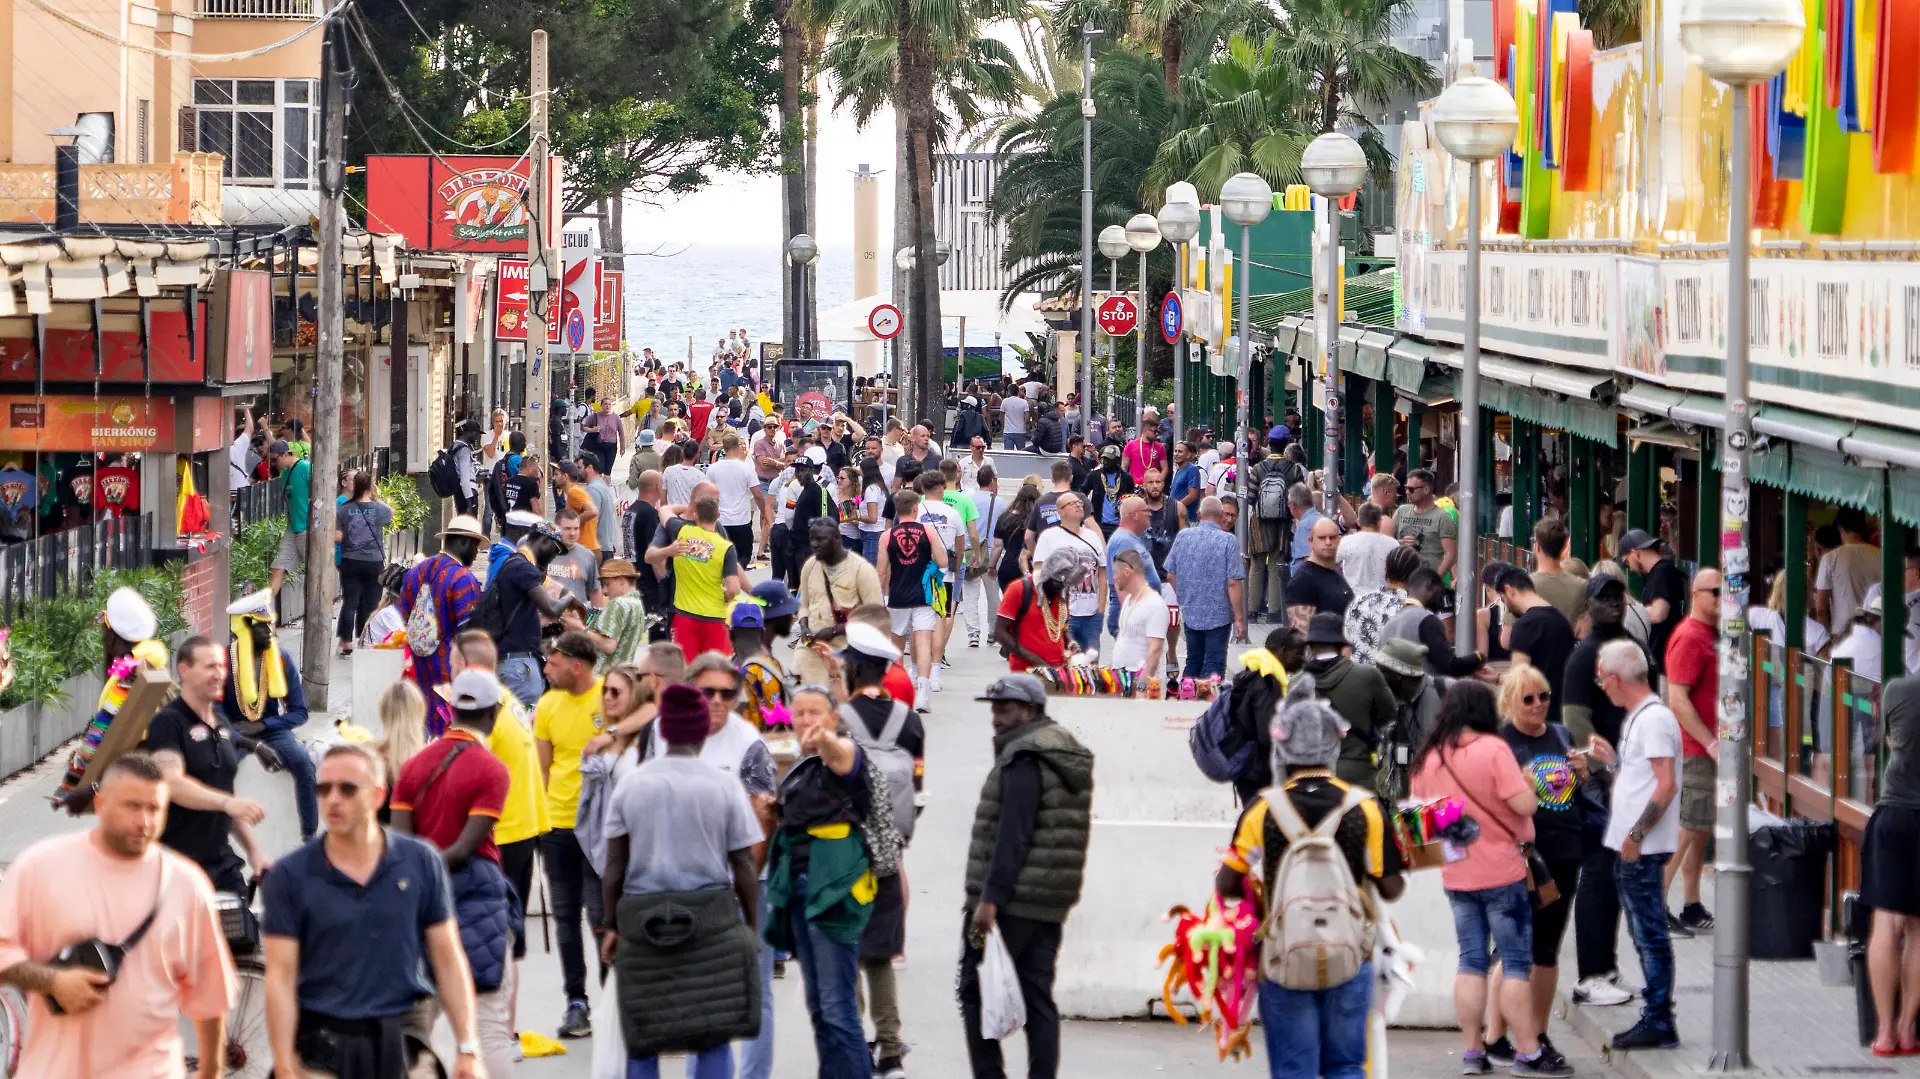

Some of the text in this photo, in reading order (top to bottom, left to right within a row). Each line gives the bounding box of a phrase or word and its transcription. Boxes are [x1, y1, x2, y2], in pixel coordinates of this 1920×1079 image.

[1102, 311, 1134, 321] STOP
[91, 427, 156, 437] BIERKÖNIG
[91, 437, 156, 447] FAN SHOP
